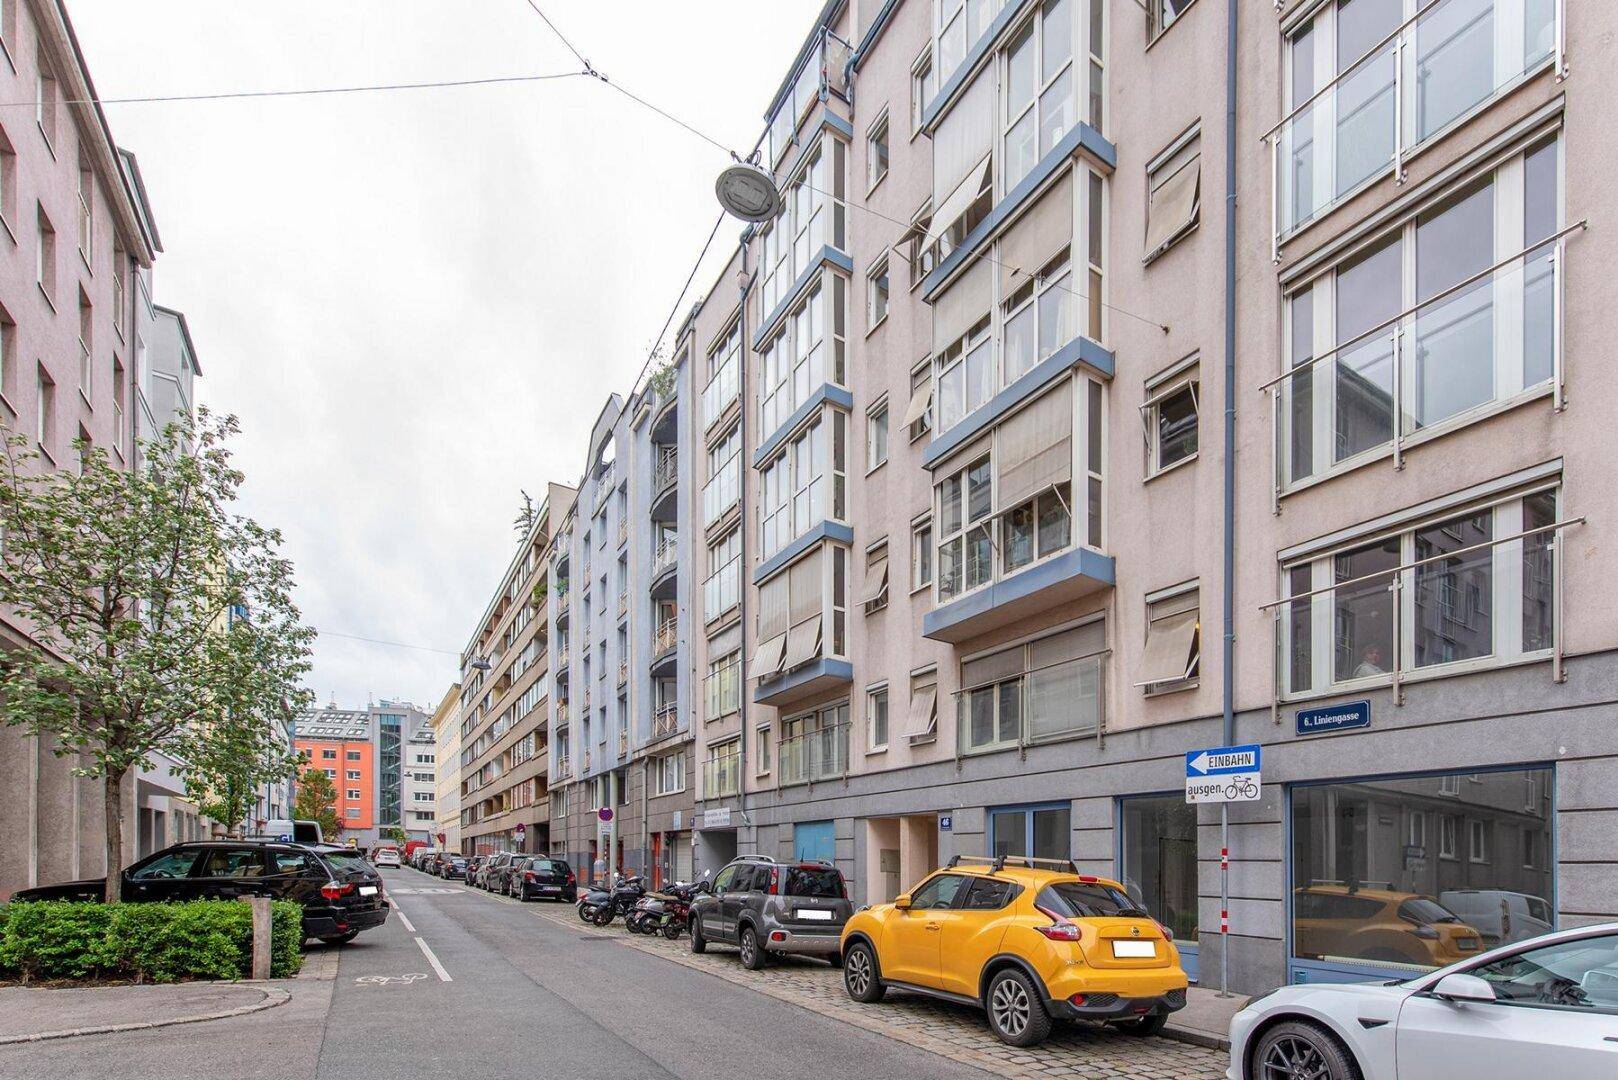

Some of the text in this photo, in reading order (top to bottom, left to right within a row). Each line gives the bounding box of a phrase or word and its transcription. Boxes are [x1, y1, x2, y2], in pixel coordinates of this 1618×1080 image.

[1314, 712, 1360, 725] Liniengasse
[1208, 753, 1252, 768] EINBAHN
[1187, 784, 1224, 797] ausgen.
